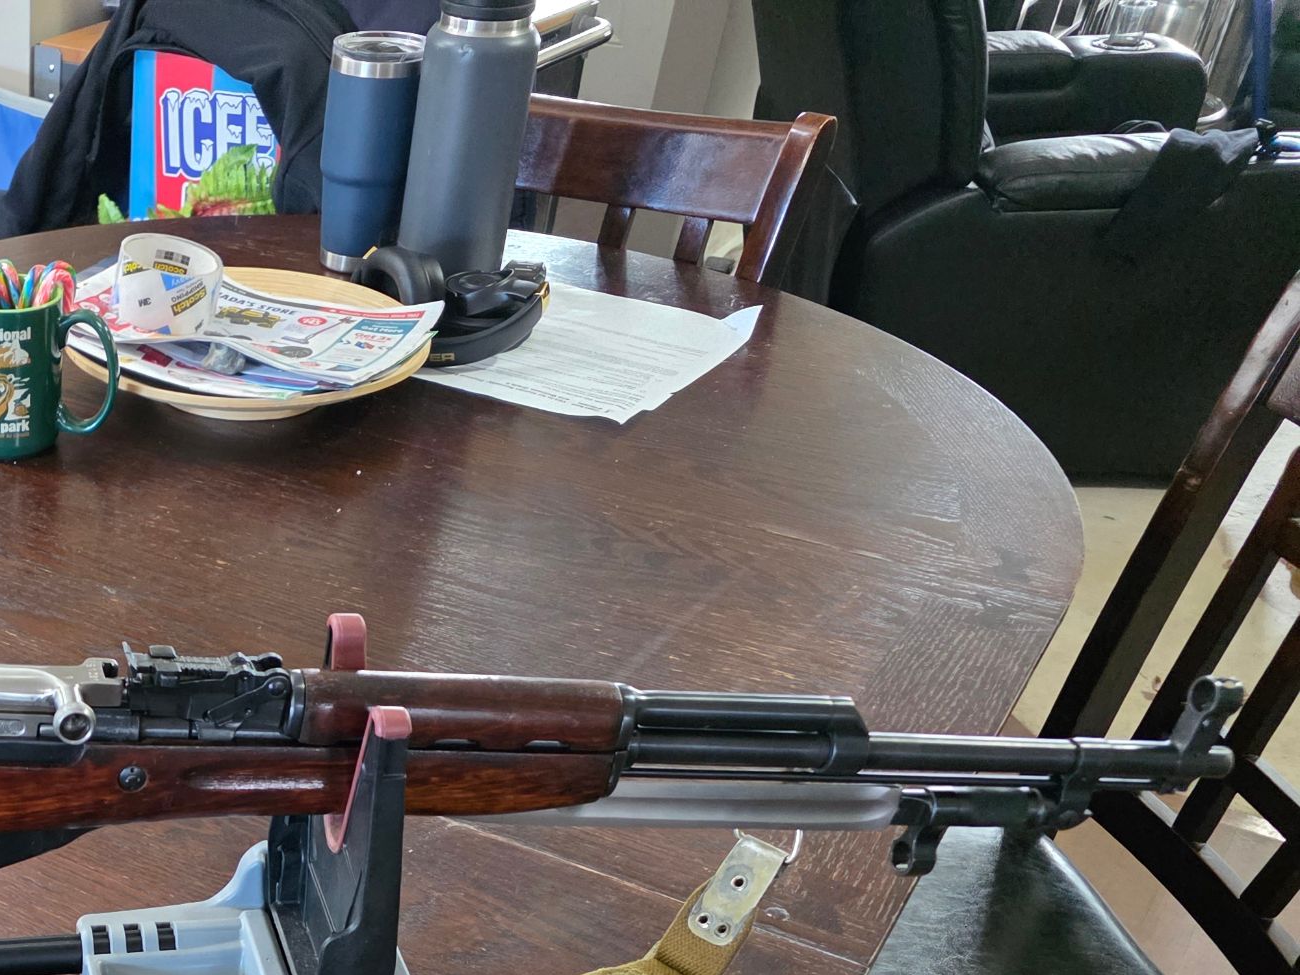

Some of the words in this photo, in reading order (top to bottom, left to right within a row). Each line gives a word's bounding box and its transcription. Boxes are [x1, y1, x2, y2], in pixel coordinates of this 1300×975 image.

[171, 281, 204, 302] SHIPPING
[173, 286, 206, 314] Scotch
[138, 297, 152, 307] 3M
[0, 419, 30, 434] park
